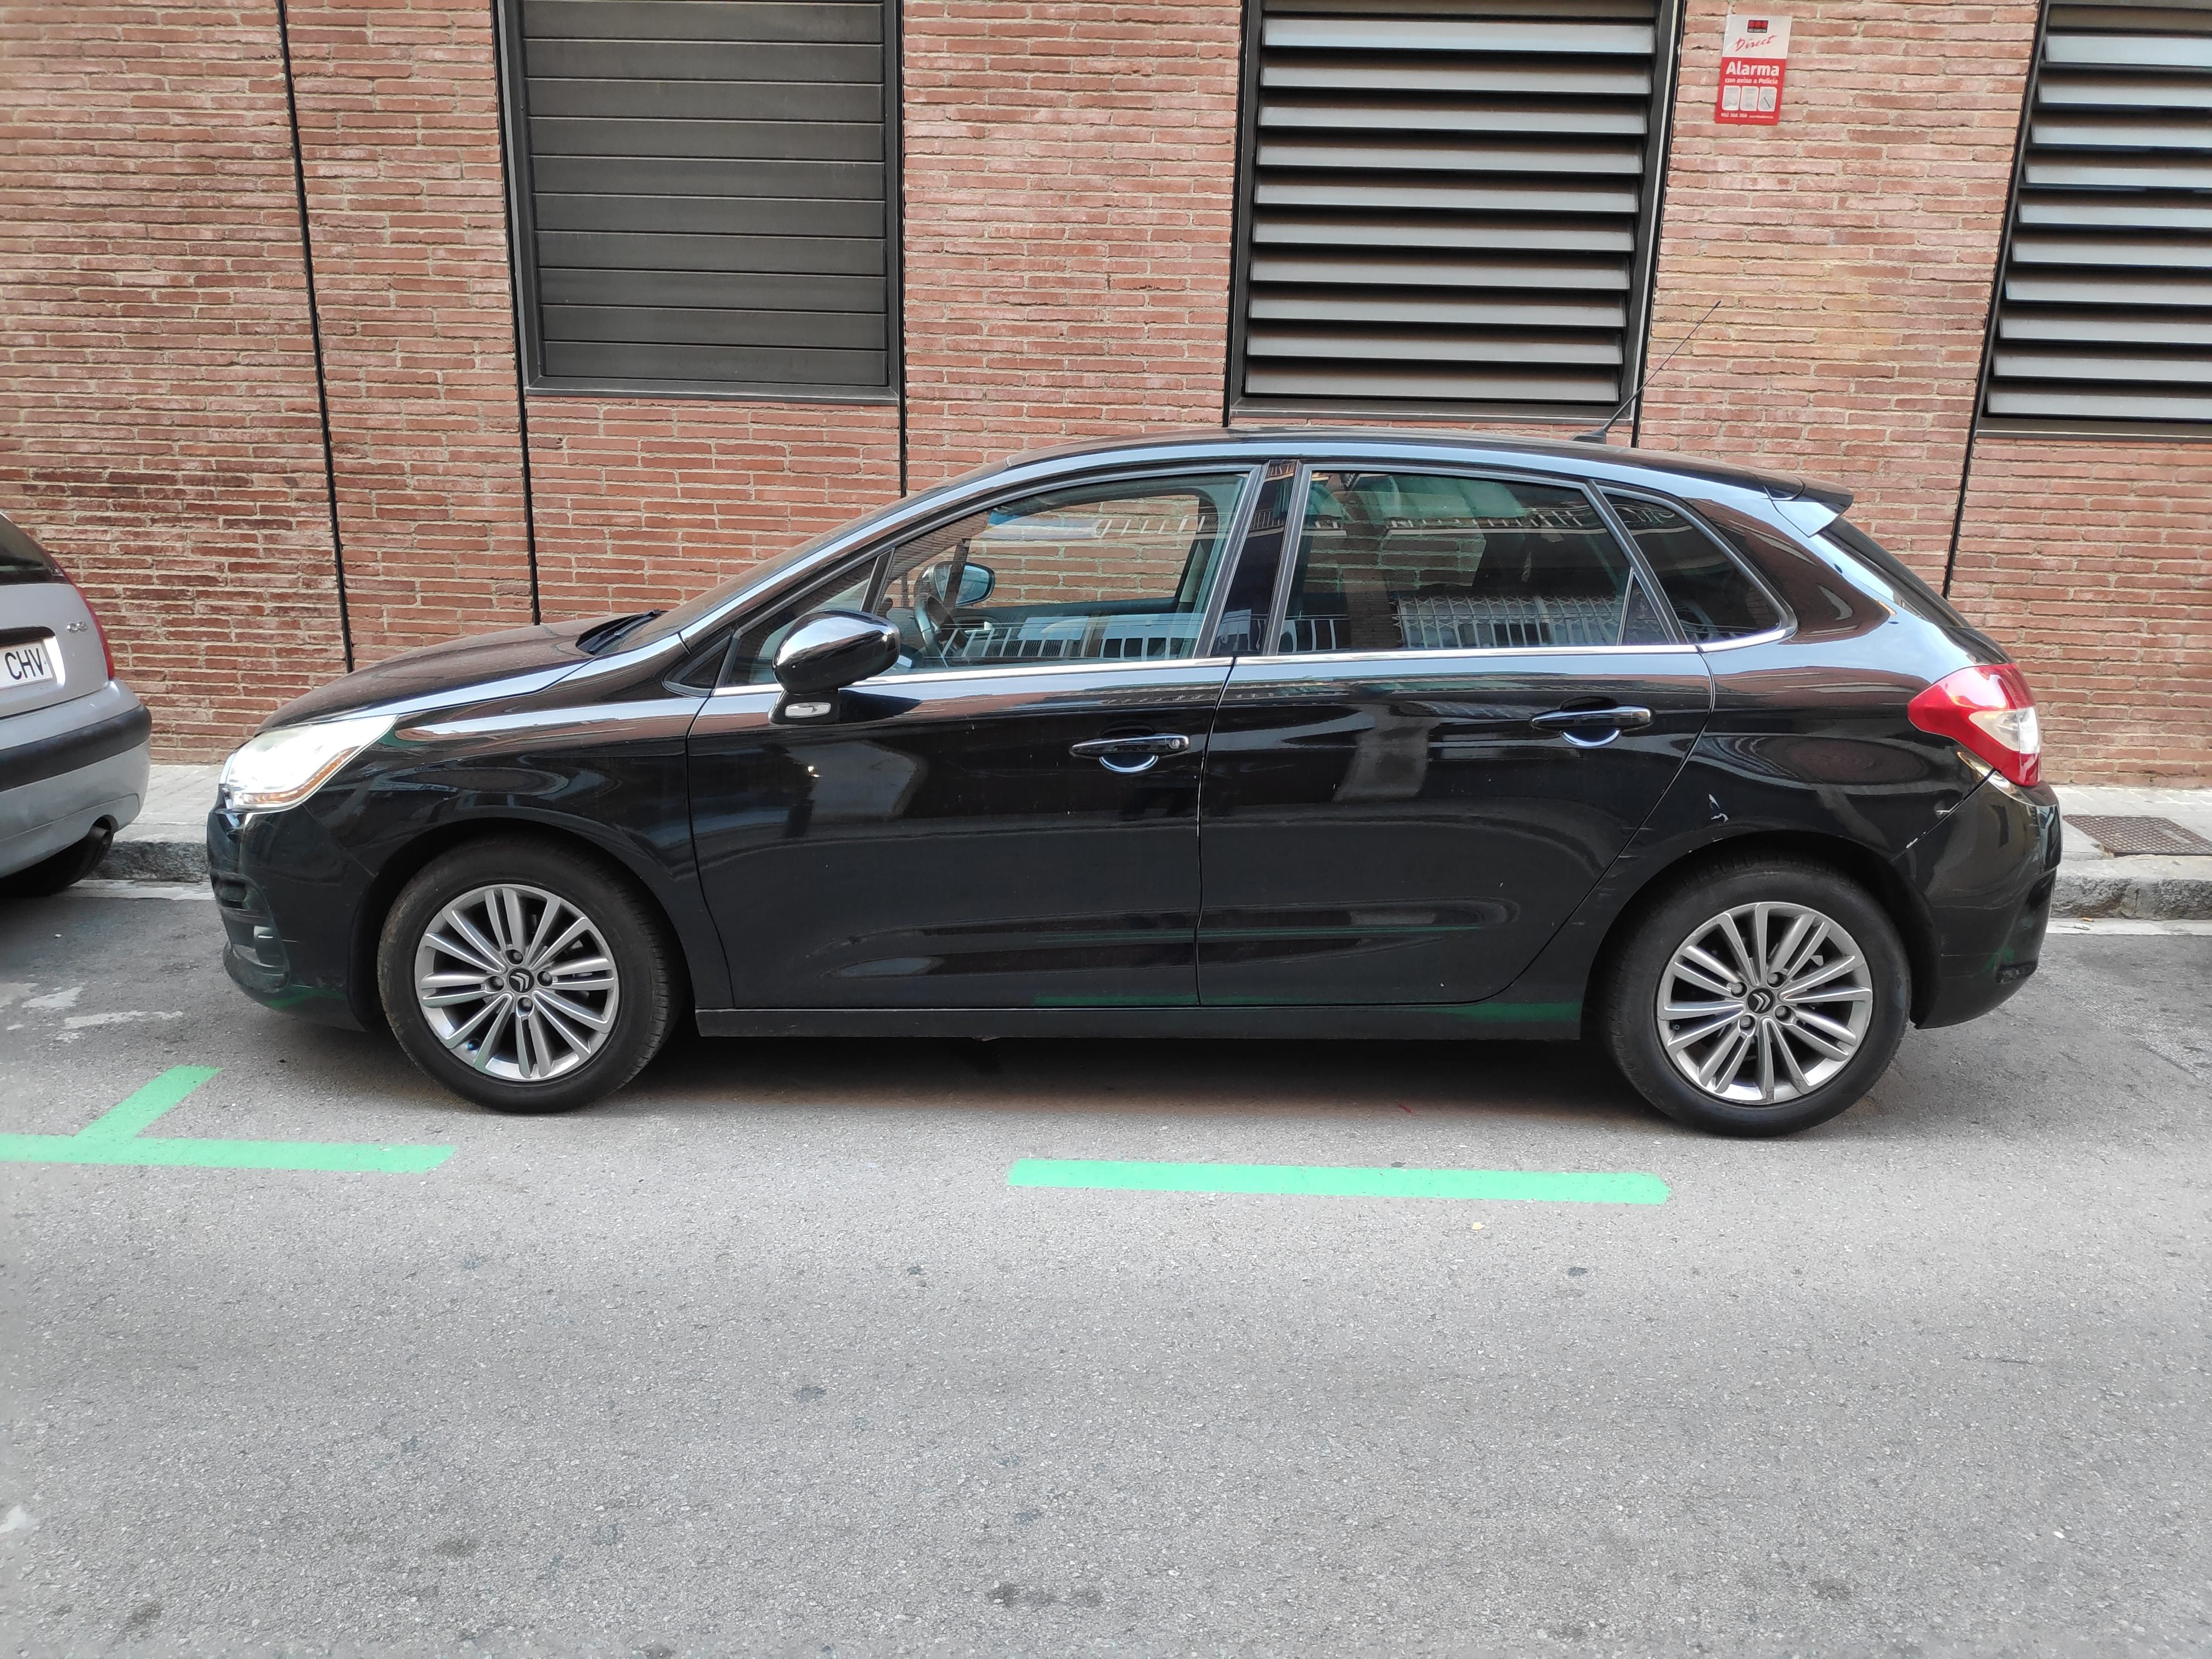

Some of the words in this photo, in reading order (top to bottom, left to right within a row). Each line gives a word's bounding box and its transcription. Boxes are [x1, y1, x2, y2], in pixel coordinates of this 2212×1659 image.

[1735, 35, 1778, 52] Direct
[1726, 61, 1780, 76] Alarma
[4, 647, 44, 680] CHV
